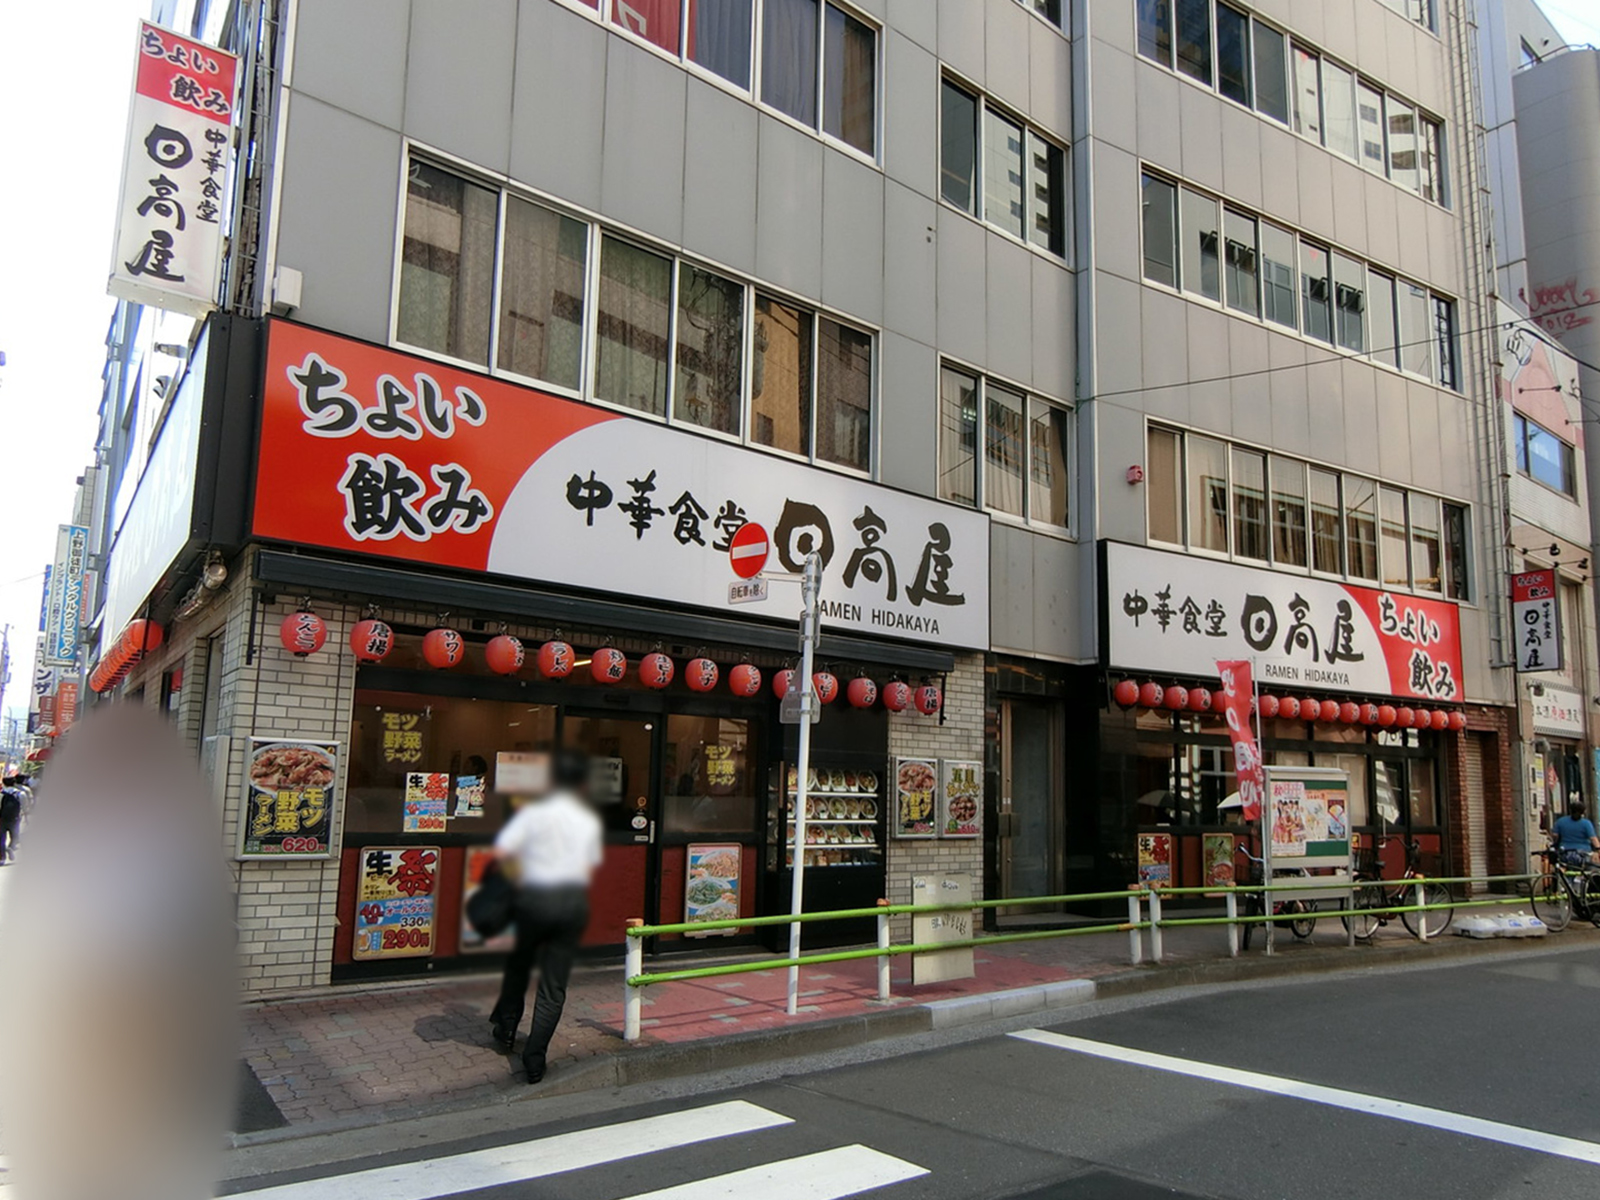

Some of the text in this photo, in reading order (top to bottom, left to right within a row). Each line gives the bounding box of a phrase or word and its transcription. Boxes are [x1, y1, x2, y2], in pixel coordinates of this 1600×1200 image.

[141, 29, 217, 75] ちょい
[171, 75, 231, 115] 飲み
[195, 127, 227, 224] 中華食堂
[125, 124, 193, 283] 日高屋
[287, 353, 487, 440] ちょい
[337, 452, 493, 541] 飲み
[566, 469, 748, 553] 中華食堂
[774, 498, 966, 607] 日高屋
[731, 583, 764, 599] 自転車を除く
[1123, 583, 1228, 637] 中華食堂
[296, 615, 319, 650] とんこつ
[819, 600, 940, 635] AMEN HIDAKAYA
[1241, 593, 1364, 664] 日高屋
[1378, 594, 1440, 645] ちょい
[367, 622, 390, 656] 唐揚
[442, 629, 460, 662] サワー
[1523, 609, 1544, 669] 日高屋
[607, 650, 623, 679] 炒飯
[700, 659, 715, 687] 餃子
[1265, 664, 1349, 685] RAMEN HIDAKAYA
[1409, 650, 1456, 700] 飲み
[381, 713, 419, 730] モツ
[384, 731, 422, 749] 野菜
[385, 749, 421, 763] ラーメン
[705, 745, 731, 759] モツ
[707, 760, 735, 774] 野菜
[252, 795, 274, 836] ラーメン
[275, 790, 301, 832] 野菜
[301, 786, 325, 828] モツ
[366, 850, 393, 877] 生
